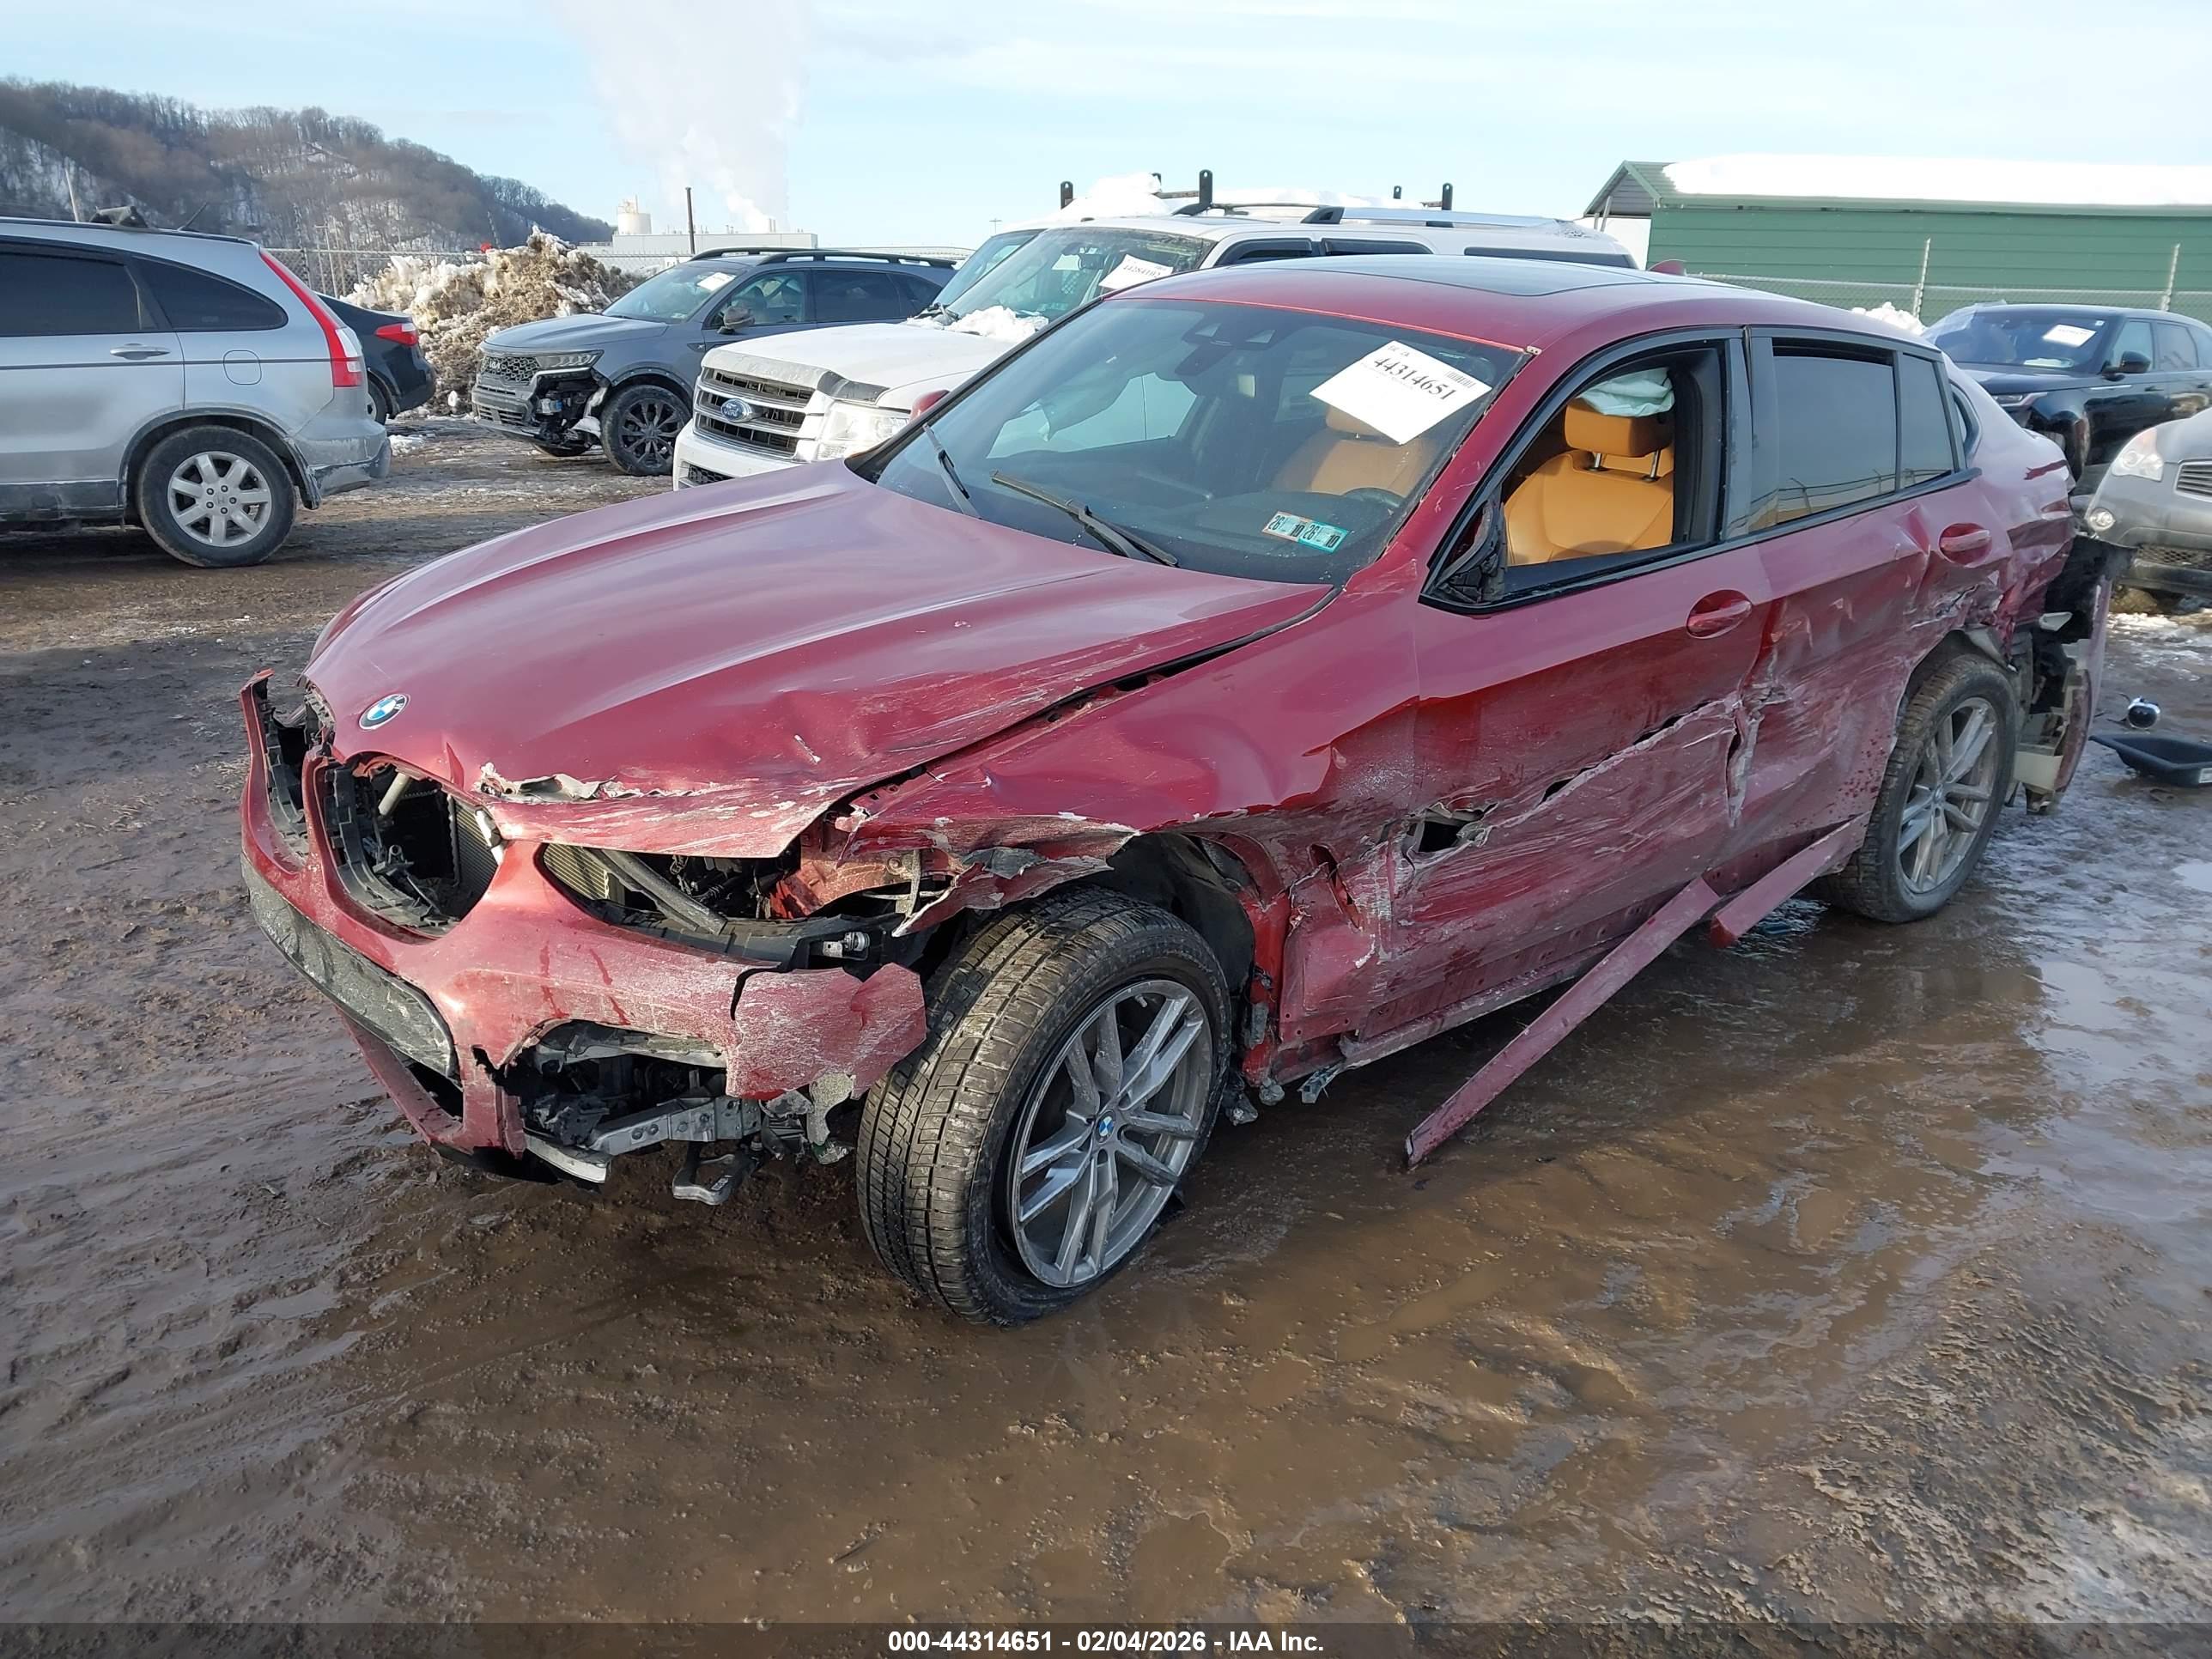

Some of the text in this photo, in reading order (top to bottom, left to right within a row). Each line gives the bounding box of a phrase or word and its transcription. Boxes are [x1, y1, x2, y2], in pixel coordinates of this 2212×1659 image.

[1374, 357, 1457, 400] 44314651
[723, 402, 739, 417] Ford
[1268, 514, 1305, 538] 26 10
[1303, 524, 1341, 548] 26 10
